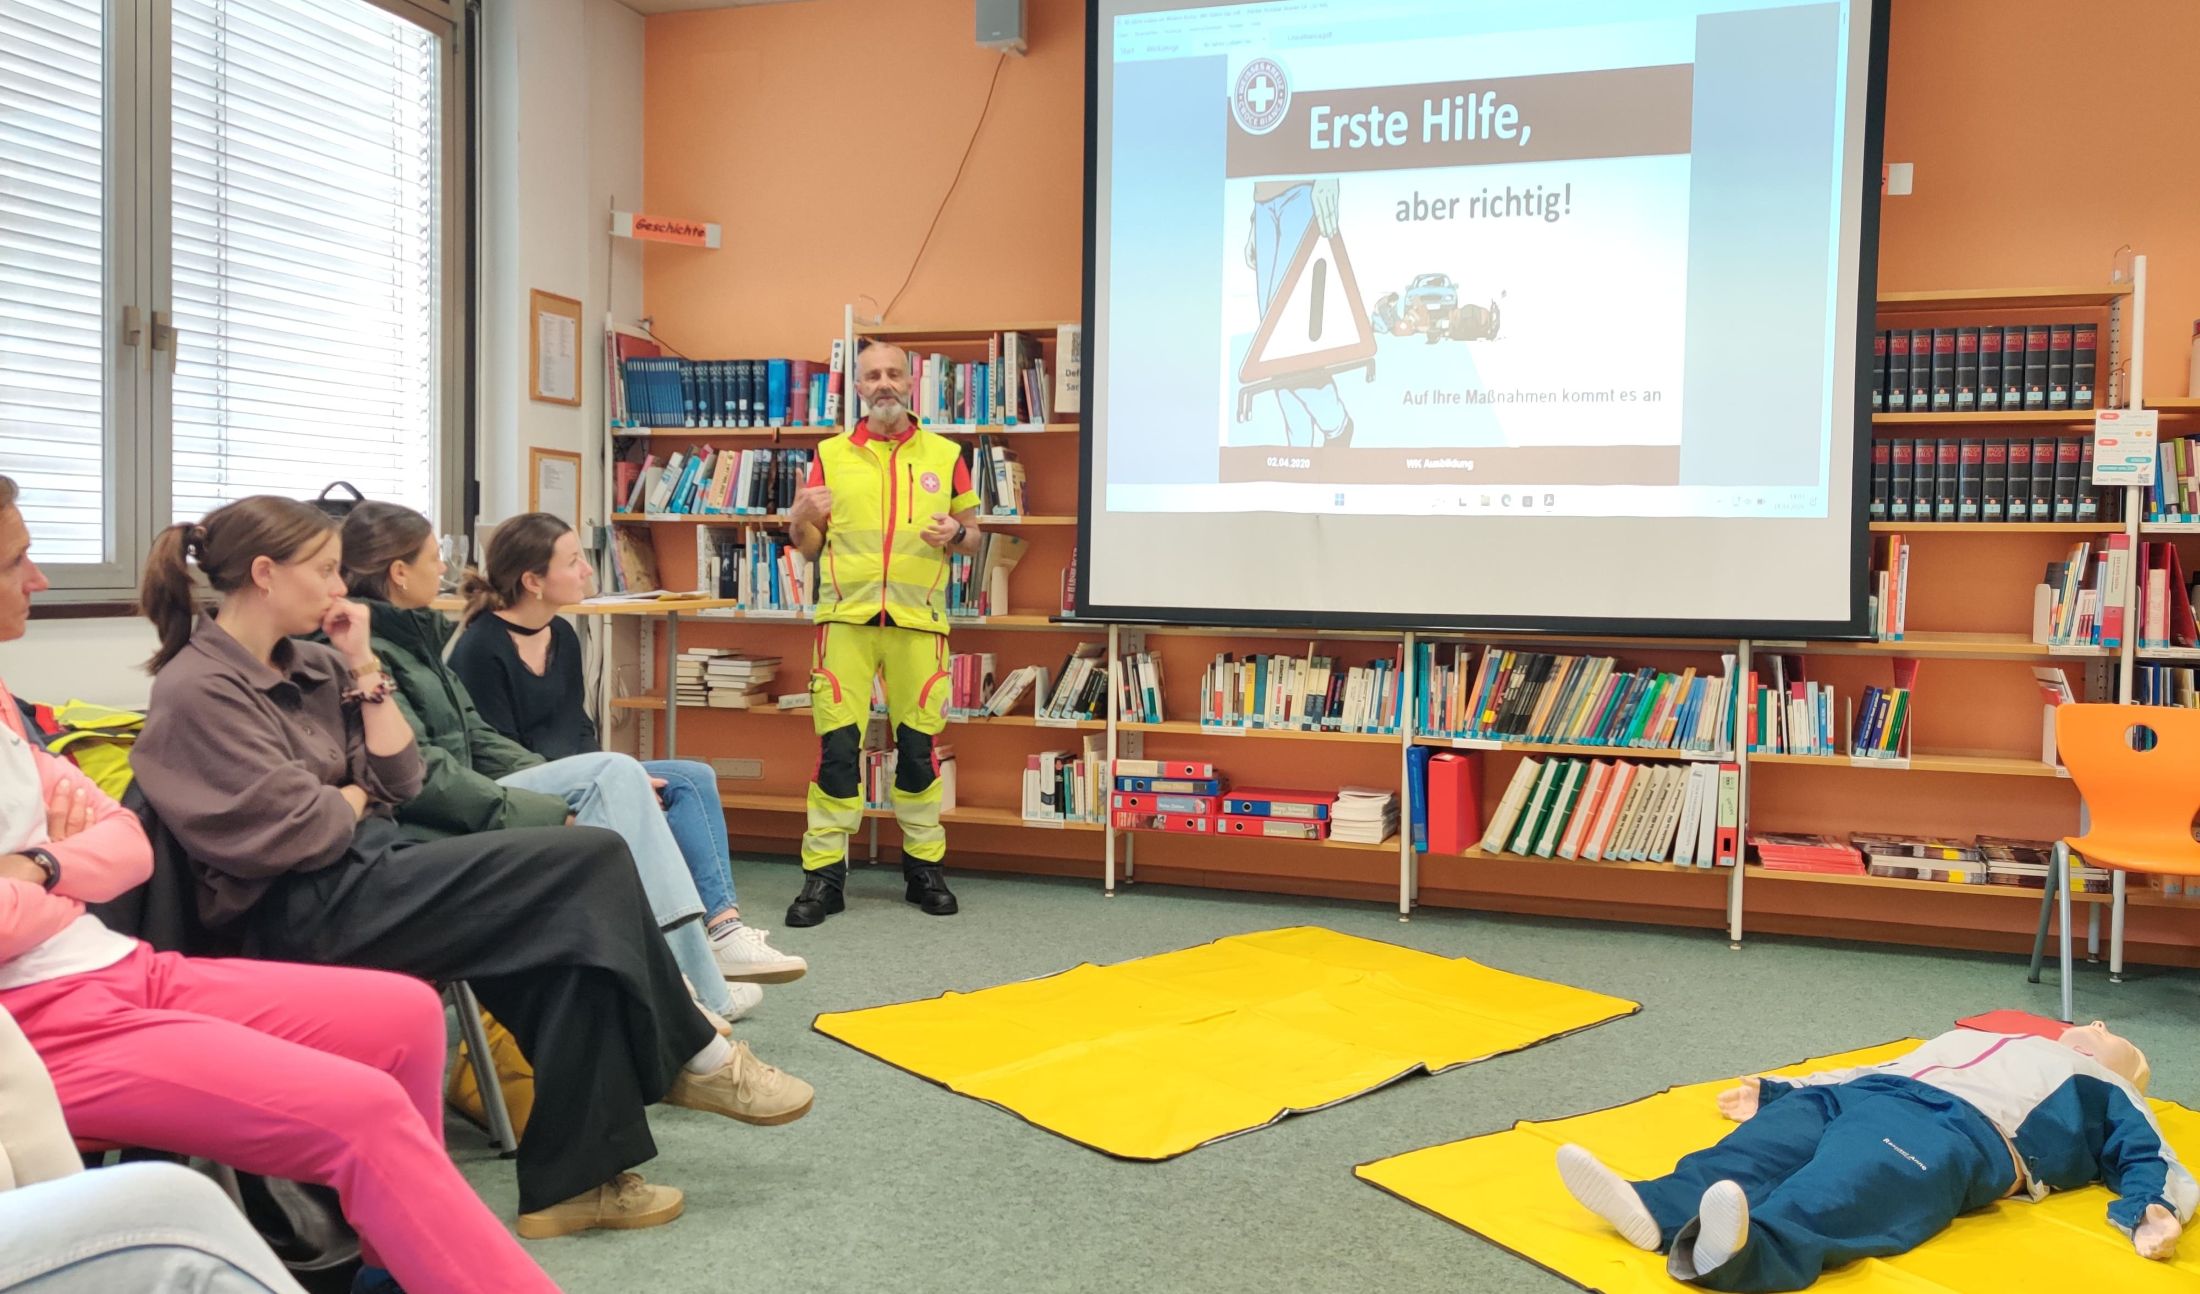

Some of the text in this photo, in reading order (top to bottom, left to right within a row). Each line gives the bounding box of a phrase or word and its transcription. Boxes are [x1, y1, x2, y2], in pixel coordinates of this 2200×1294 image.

[1310, 90, 1531, 150] Erste Hilfe,
[1395, 183, 1571, 223] aber richtig!
[635, 218, 705, 237] Geschichte
[1402, 387, 1662, 405] Auf Ihre Maßnahmen kommt es an
[1423, 458, 1474, 471] Ausbildung
